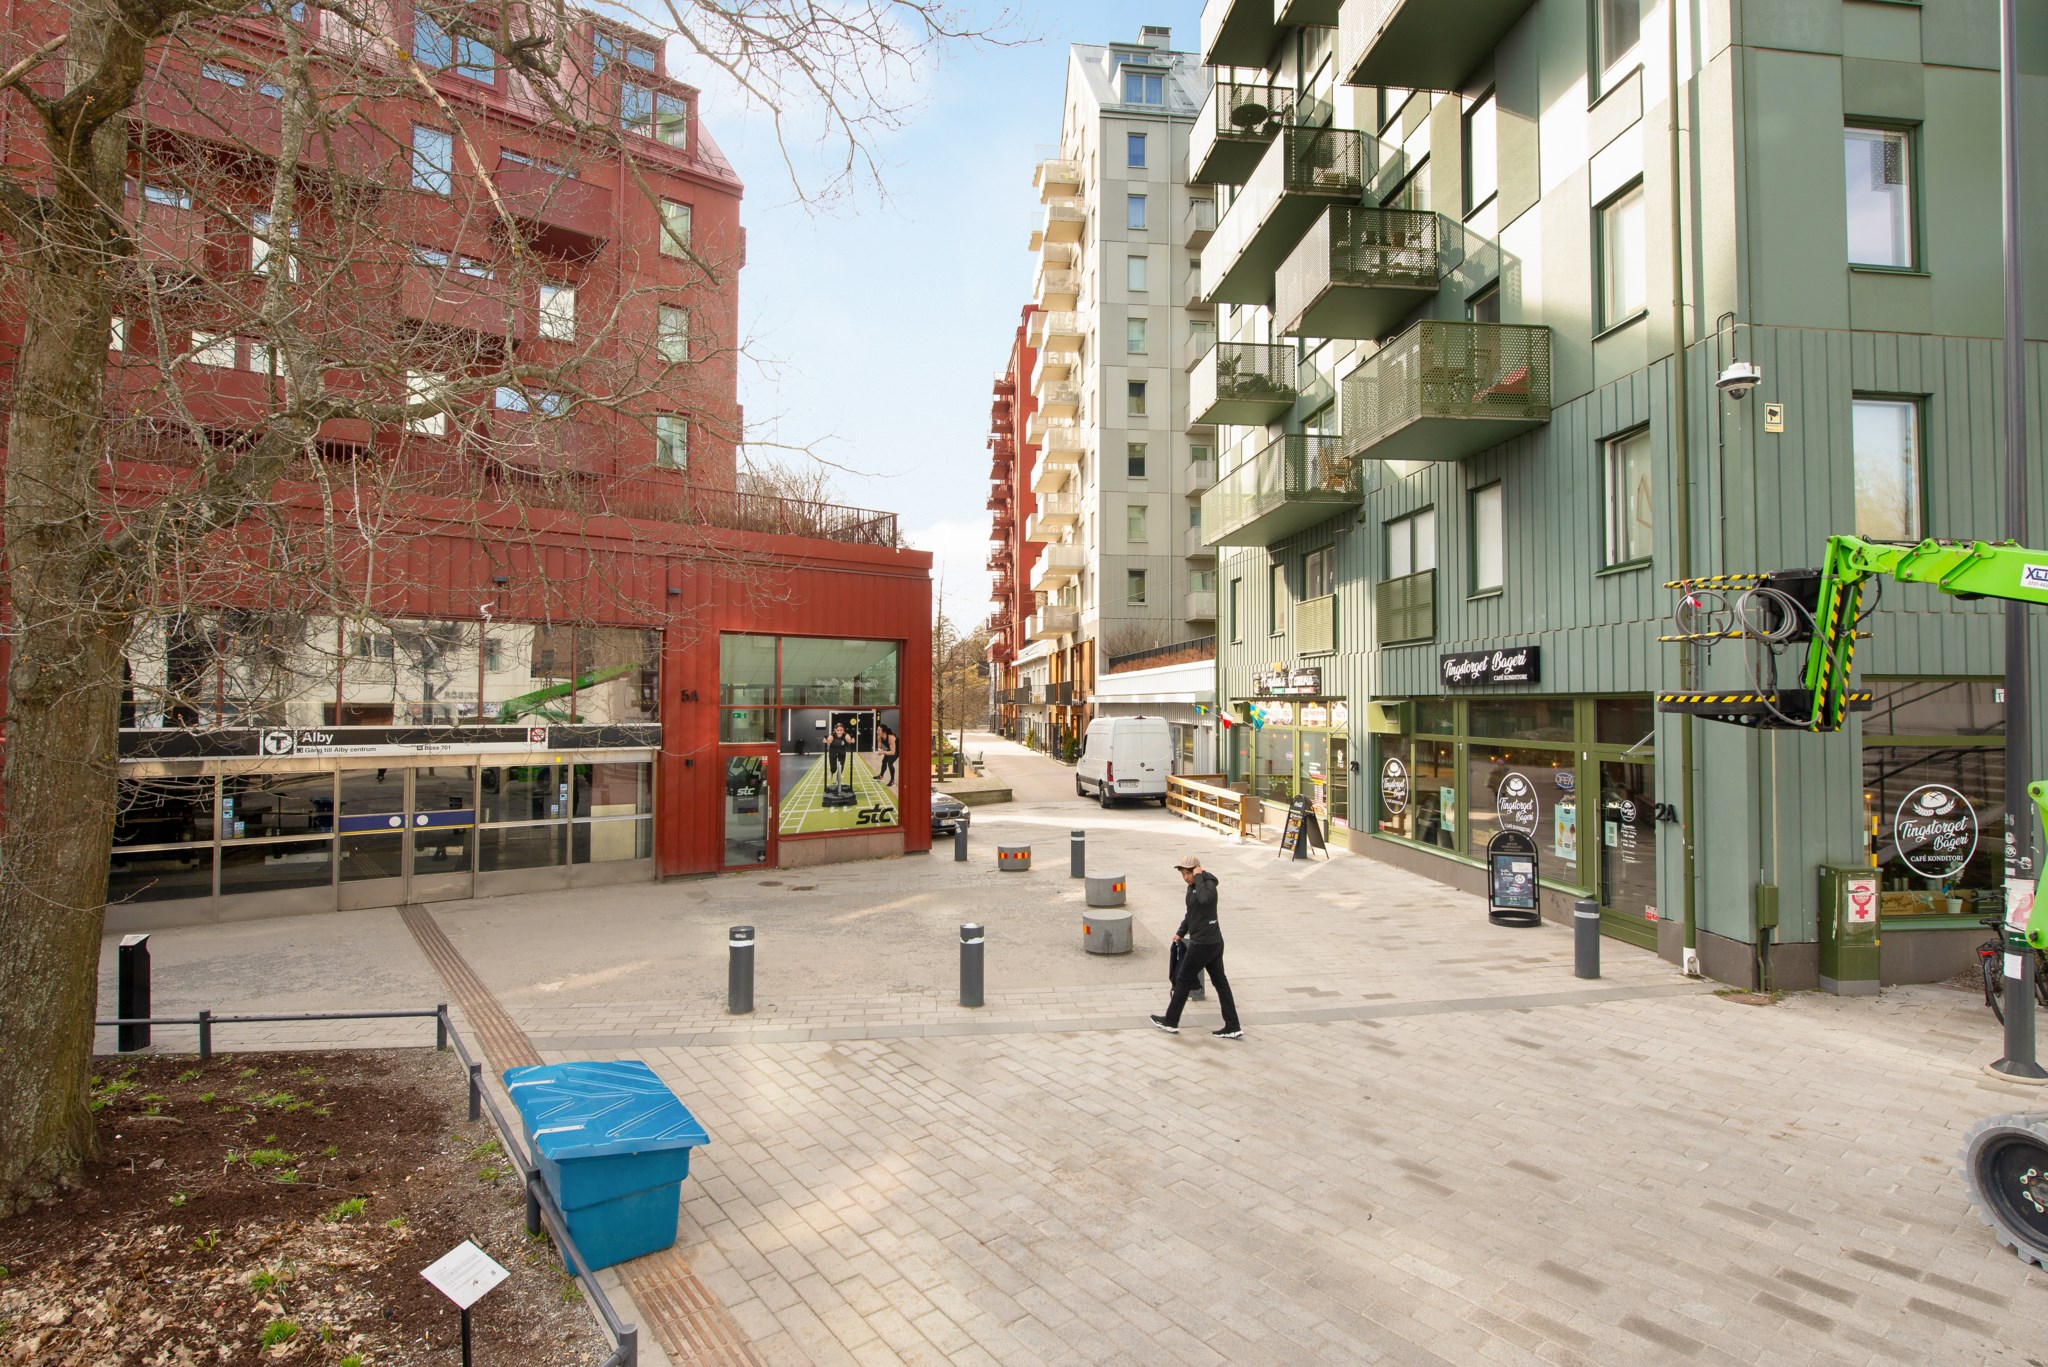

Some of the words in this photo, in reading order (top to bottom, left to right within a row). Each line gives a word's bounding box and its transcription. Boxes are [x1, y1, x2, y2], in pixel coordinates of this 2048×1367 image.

[1444, 656, 1489, 681] Tingstorget
[1491, 650, 1527, 674] Bageri
[681, 689, 699, 703] 5A
[302, 731, 334, 744] Alby
[334, 746, 348, 754] Alby
[737, 785, 755, 796] stc
[1499, 797, 1534, 814] Tingstorget
[1655, 803, 1679, 823] 2A
[856, 804, 894, 825] stc
[1515, 812, 1534, 824] Bageri
[1899, 816, 1969, 843] Tingstorget
[1933, 833, 1969, 852] Bageri
[1910, 854, 1927, 862] CAFÉ
